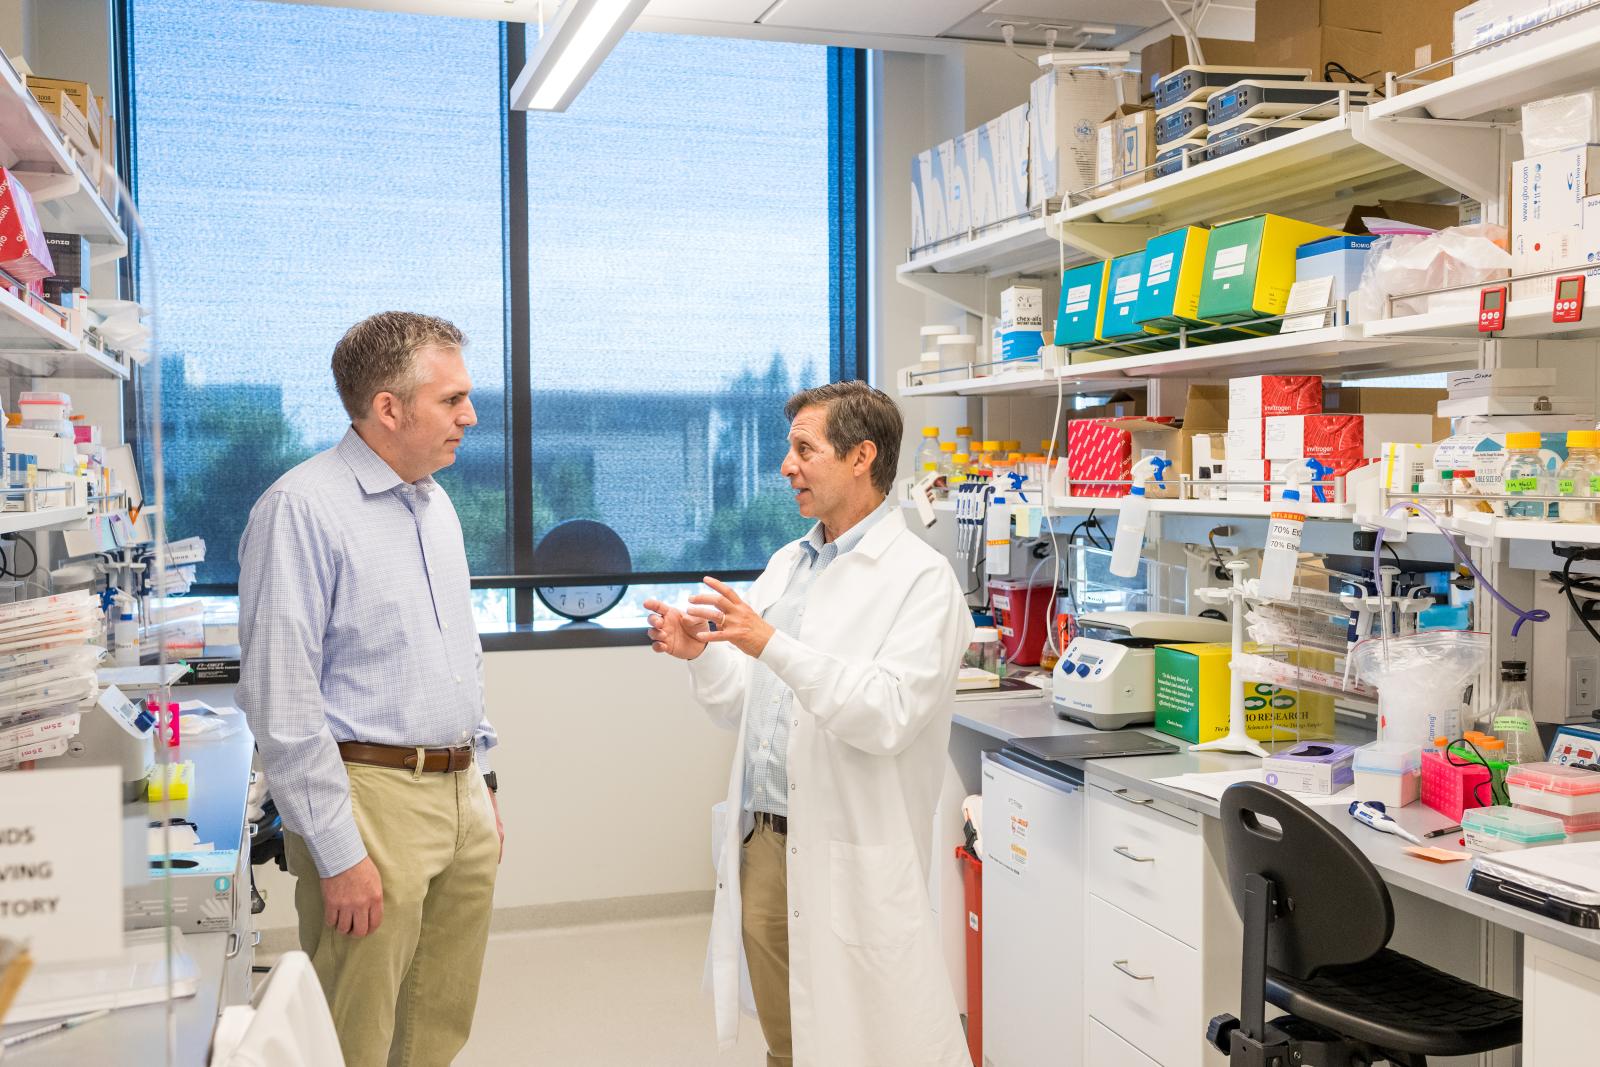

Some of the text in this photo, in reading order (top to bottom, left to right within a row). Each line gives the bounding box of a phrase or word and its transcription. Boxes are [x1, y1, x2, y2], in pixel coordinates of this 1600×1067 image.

[1264, 404, 1292, 413] invitrogen
[1306, 445, 1334, 454] invitrogen
[1273, 526, 1290, 535] 70%
[1270, 541, 1285, 549] 70%
[560, 594, 567, 606] 7
[578, 598, 585, 609] 6
[1258, 711, 1309, 721] RESEARCH
[0, 897, 60, 917] TORY
